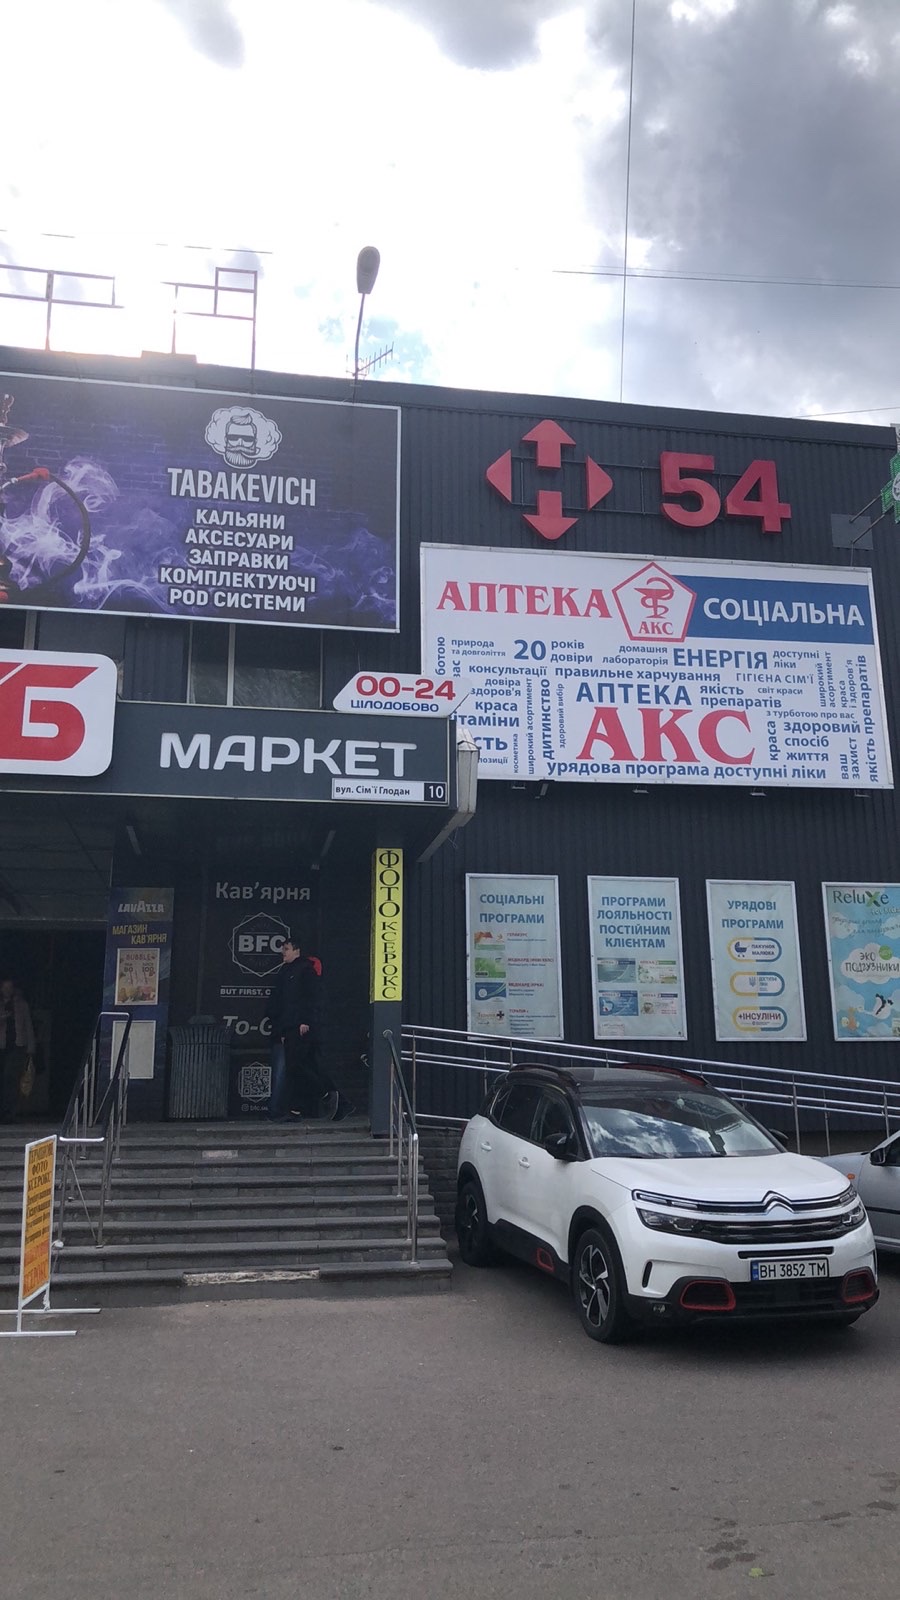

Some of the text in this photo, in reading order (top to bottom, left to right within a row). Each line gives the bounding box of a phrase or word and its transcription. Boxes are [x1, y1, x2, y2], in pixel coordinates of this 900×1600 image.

[167, 467, 316, 507] TABAKEVICH
[660, 451, 792, 533] 54
[196, 508, 285, 530] КАЛЬЯНИ
[185, 528, 294, 551] АКСЕСУАРИ
[189, 548, 289, 571] ЗАПРАВКИ
[160, 567, 316, 593] КОМПЛЕКТУЮЧІ
[169, 588, 306, 613] POD СИСТЕМИ
[436, 580, 613, 618] АПТЕКА
[703, 597, 865, 627] СОЦІАЛЬНА
[638, 621, 674, 636] АКС
[451, 638, 495, 649] природа
[513, 639, 547, 661] 20
[550, 639, 585, 651] років
[618, 644, 668, 655] домашня
[435, 636, 446, 676] ботою
[452, 649, 506, 659] та довголіття
[550, 652, 593, 664] довіри
[602, 654, 669, 666] лабораторія
[672, 648, 768, 670] ЕНЕРГІЯ
[772, 649, 820, 660] доступні
[468, 664, 548, 678] консультації
[773, 659, 797, 669] ліки
[555, 666, 721, 683] правильне харчування
[736, 672, 815, 685] ГІГІЄНА СІМ'Ї
[825, 651, 836, 708] асортимент
[356, 675, 456, 701] 00-24
[484, 677, 521, 688] довіра
[816, 662, 828, 707] широкий
[470, 687, 522, 698] здоров'я
[576, 682, 692, 706] АПТЕКА
[700, 684, 744, 696] якість
[757, 686, 803, 697] світ краси
[839, 680, 849, 708] краса
[557, 683, 565, 712] вибір
[700, 697, 782, 710] препаратів
[350, 699, 439, 713] ЦІЛОДОБОВО
[475, 700, 519, 714] краса
[454, 711, 520, 728] ітаміни
[540, 678, 556, 761] дитинство
[772, 710, 819, 720] турботою
[820, 711, 838, 721] про
[840, 712, 855, 720] вас
[855, 654, 879, 783] якість препаратів
[526, 678, 536, 775] широкий асортимент
[783, 719, 861, 735] здоровий
[474, 735, 508, 751] сть
[576, 706, 756, 766] АКС
[767, 720, 779, 761] краса
[784, 735, 830, 749] спосіб
[159, 732, 417, 777] МАРКЕТ
[786, 750, 829, 762] життя
[849, 737, 860, 779] захист
[547, 760, 827, 781] урядова програма доступні ліки
[839, 753, 849, 780] ваш
[335, 786, 354, 795] вул.
[379, 786, 410, 796] Глодан
[429, 785, 444, 799] 10
[479, 893, 545, 906] СОЦІАЛЬНІ
[601, 896, 666, 907] ПРОГРАМИ
[727, 900, 776, 912] УРЯДОВІ
[479, 912, 545, 924] ПРОГРАМИ
[596, 909, 672, 921] ЛОЯЛЬНОСТІ
[112, 924, 148, 935] МАГАЗИН
[599, 923, 671, 936] ПОСТІЙНИМ
[722, 918, 784, 929] ПРОГРАМИ
[131, 933, 167, 945] КАВ'ЯРНЯ
[238, 935, 284, 953] BFC
[605, 938, 666, 949] КЛІЄНТАМ
[859, 952, 876, 962] ЭКО
[845, 961, 900, 972] ПОДГУЗНИКИ
[239, 988, 264, 997] FIRST,
[222, 1015, 273, 1036] To-G
[759, 1264, 776, 1278] BH
[780, 1263, 806, 1277] 3852
[809, 1262, 826, 1276] TM
